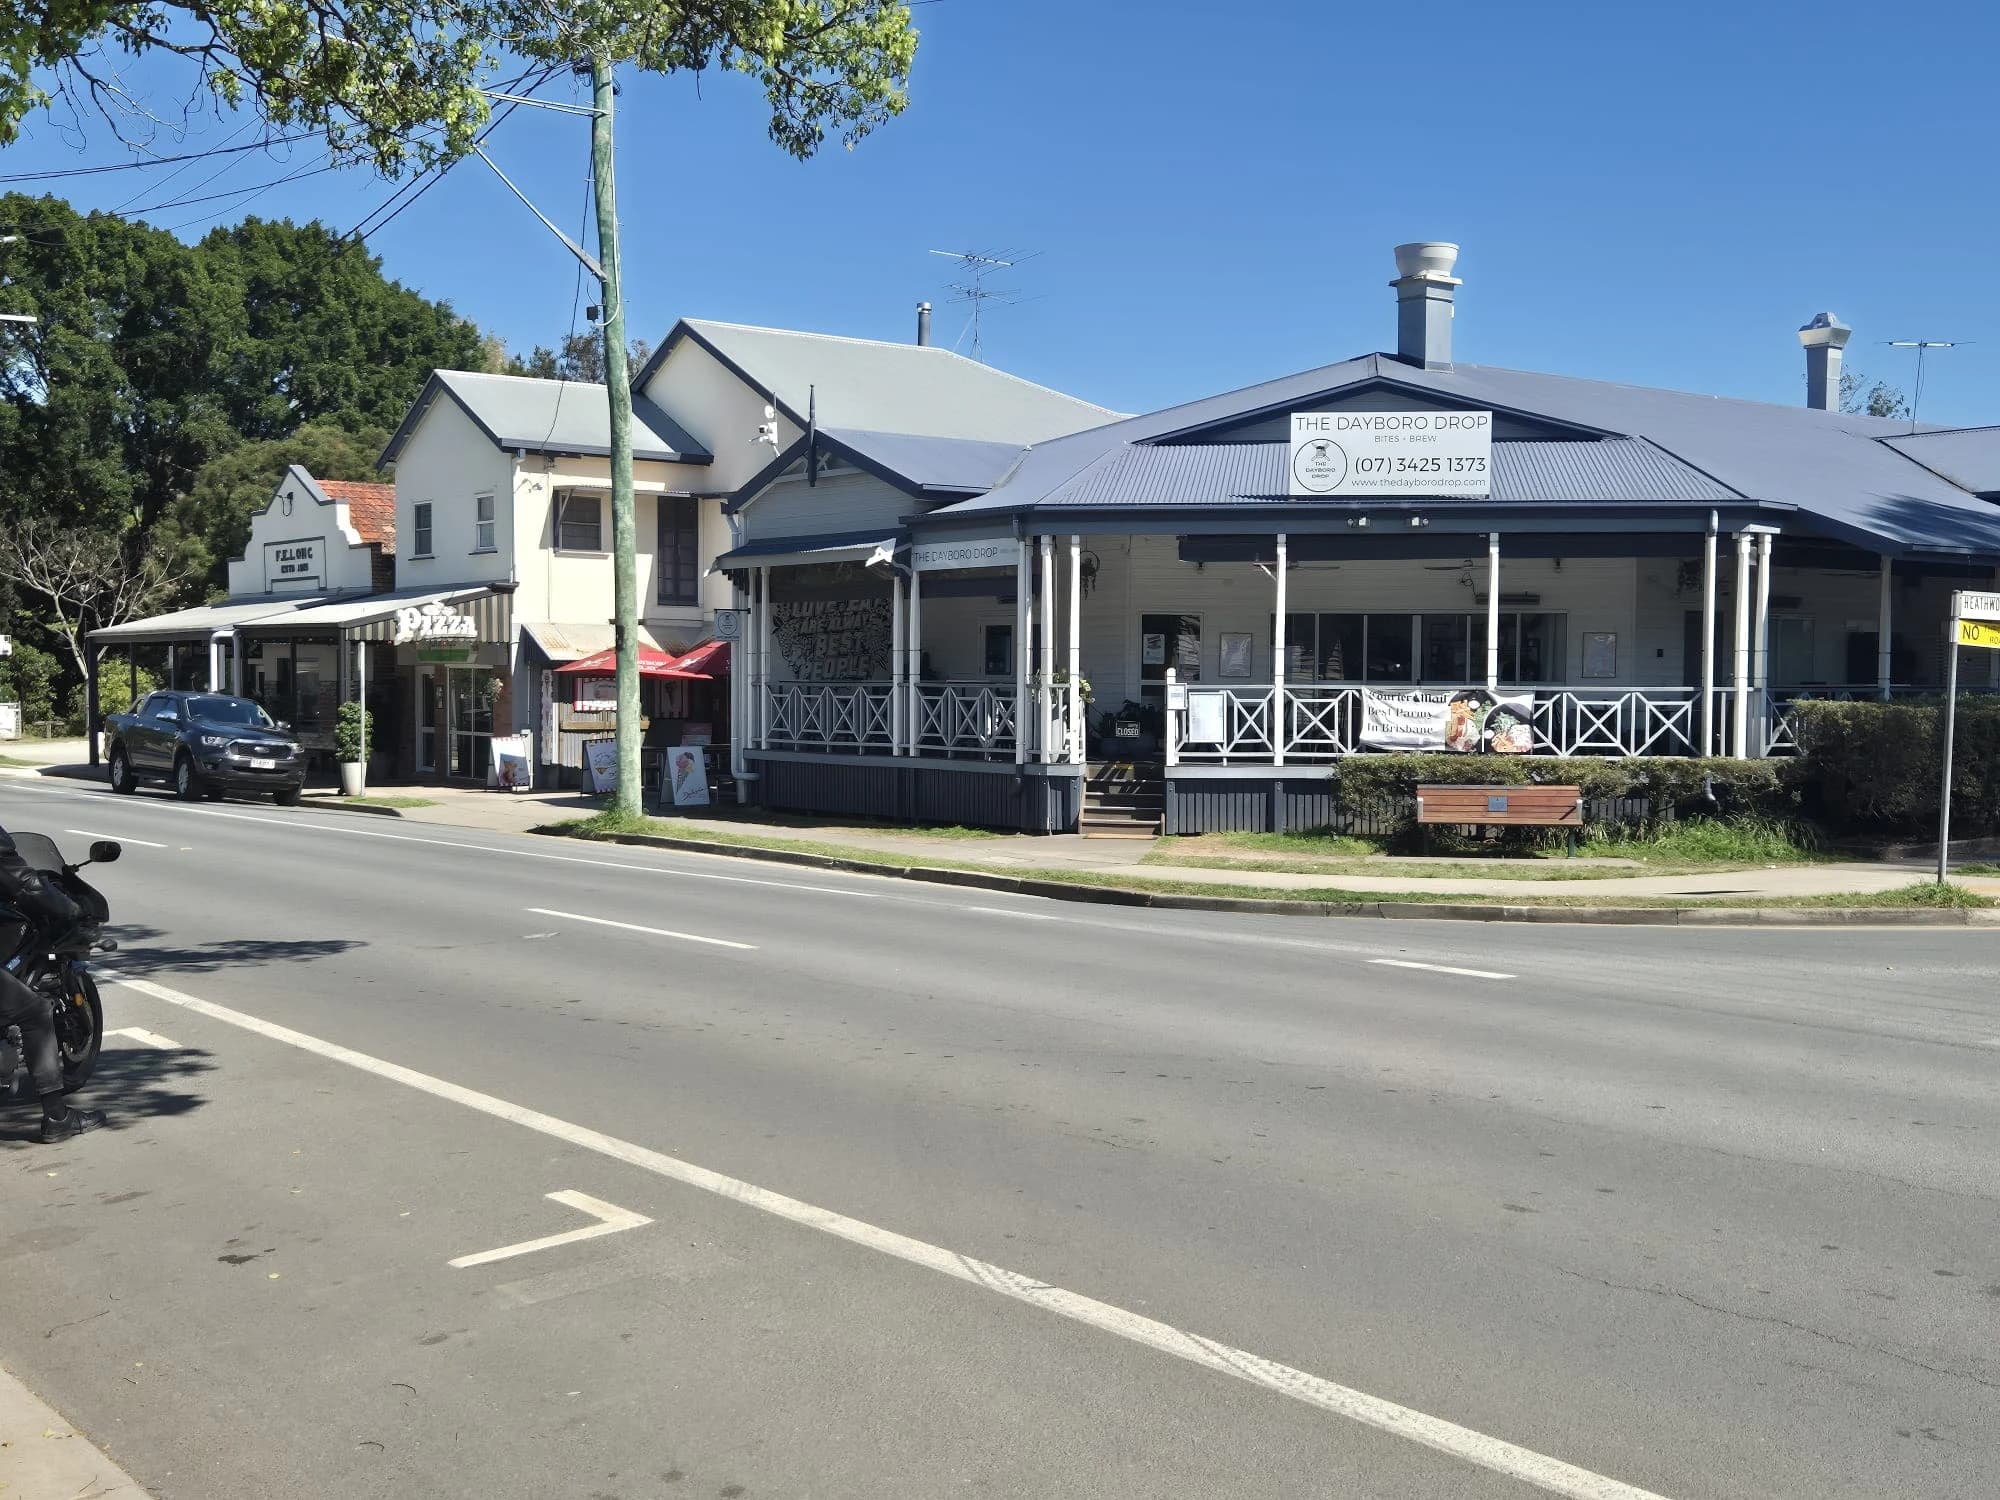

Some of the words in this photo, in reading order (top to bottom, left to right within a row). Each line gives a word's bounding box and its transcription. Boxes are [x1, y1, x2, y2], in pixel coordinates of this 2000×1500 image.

[1295, 416, 1330, 431] THE
[1337, 415, 1428, 430] DAYBORO
[1435, 415, 1488, 430] DROP
[1374, 435, 1400, 443] BITES
[1409, 435, 1437, 443] BREW
[1355, 457, 1392, 475] (07)
[1396, 457, 1441, 472] 3425
[1447, 457, 1486, 472] 1373
[1351, 478, 1486, 489] www.thedayborodrop.com
[914, 551, 930, 562] THE
[931, 549, 972, 561] DAYBORO
[973, 546, 998, 559] DROP
[1962, 624, 1980, 641] NO
[815, 632, 863, 657] BEST
[798, 656, 870, 681] PEOPLE
[1421, 692, 1448, 704] Mail
[1368, 706, 1391, 716] Best
[1396, 708, 1433, 720] Parmy
[1117, 728, 1139, 736] CLOSED
[1367, 722, 1379, 732] In
[1382, 723, 1433, 735] Brisbane
